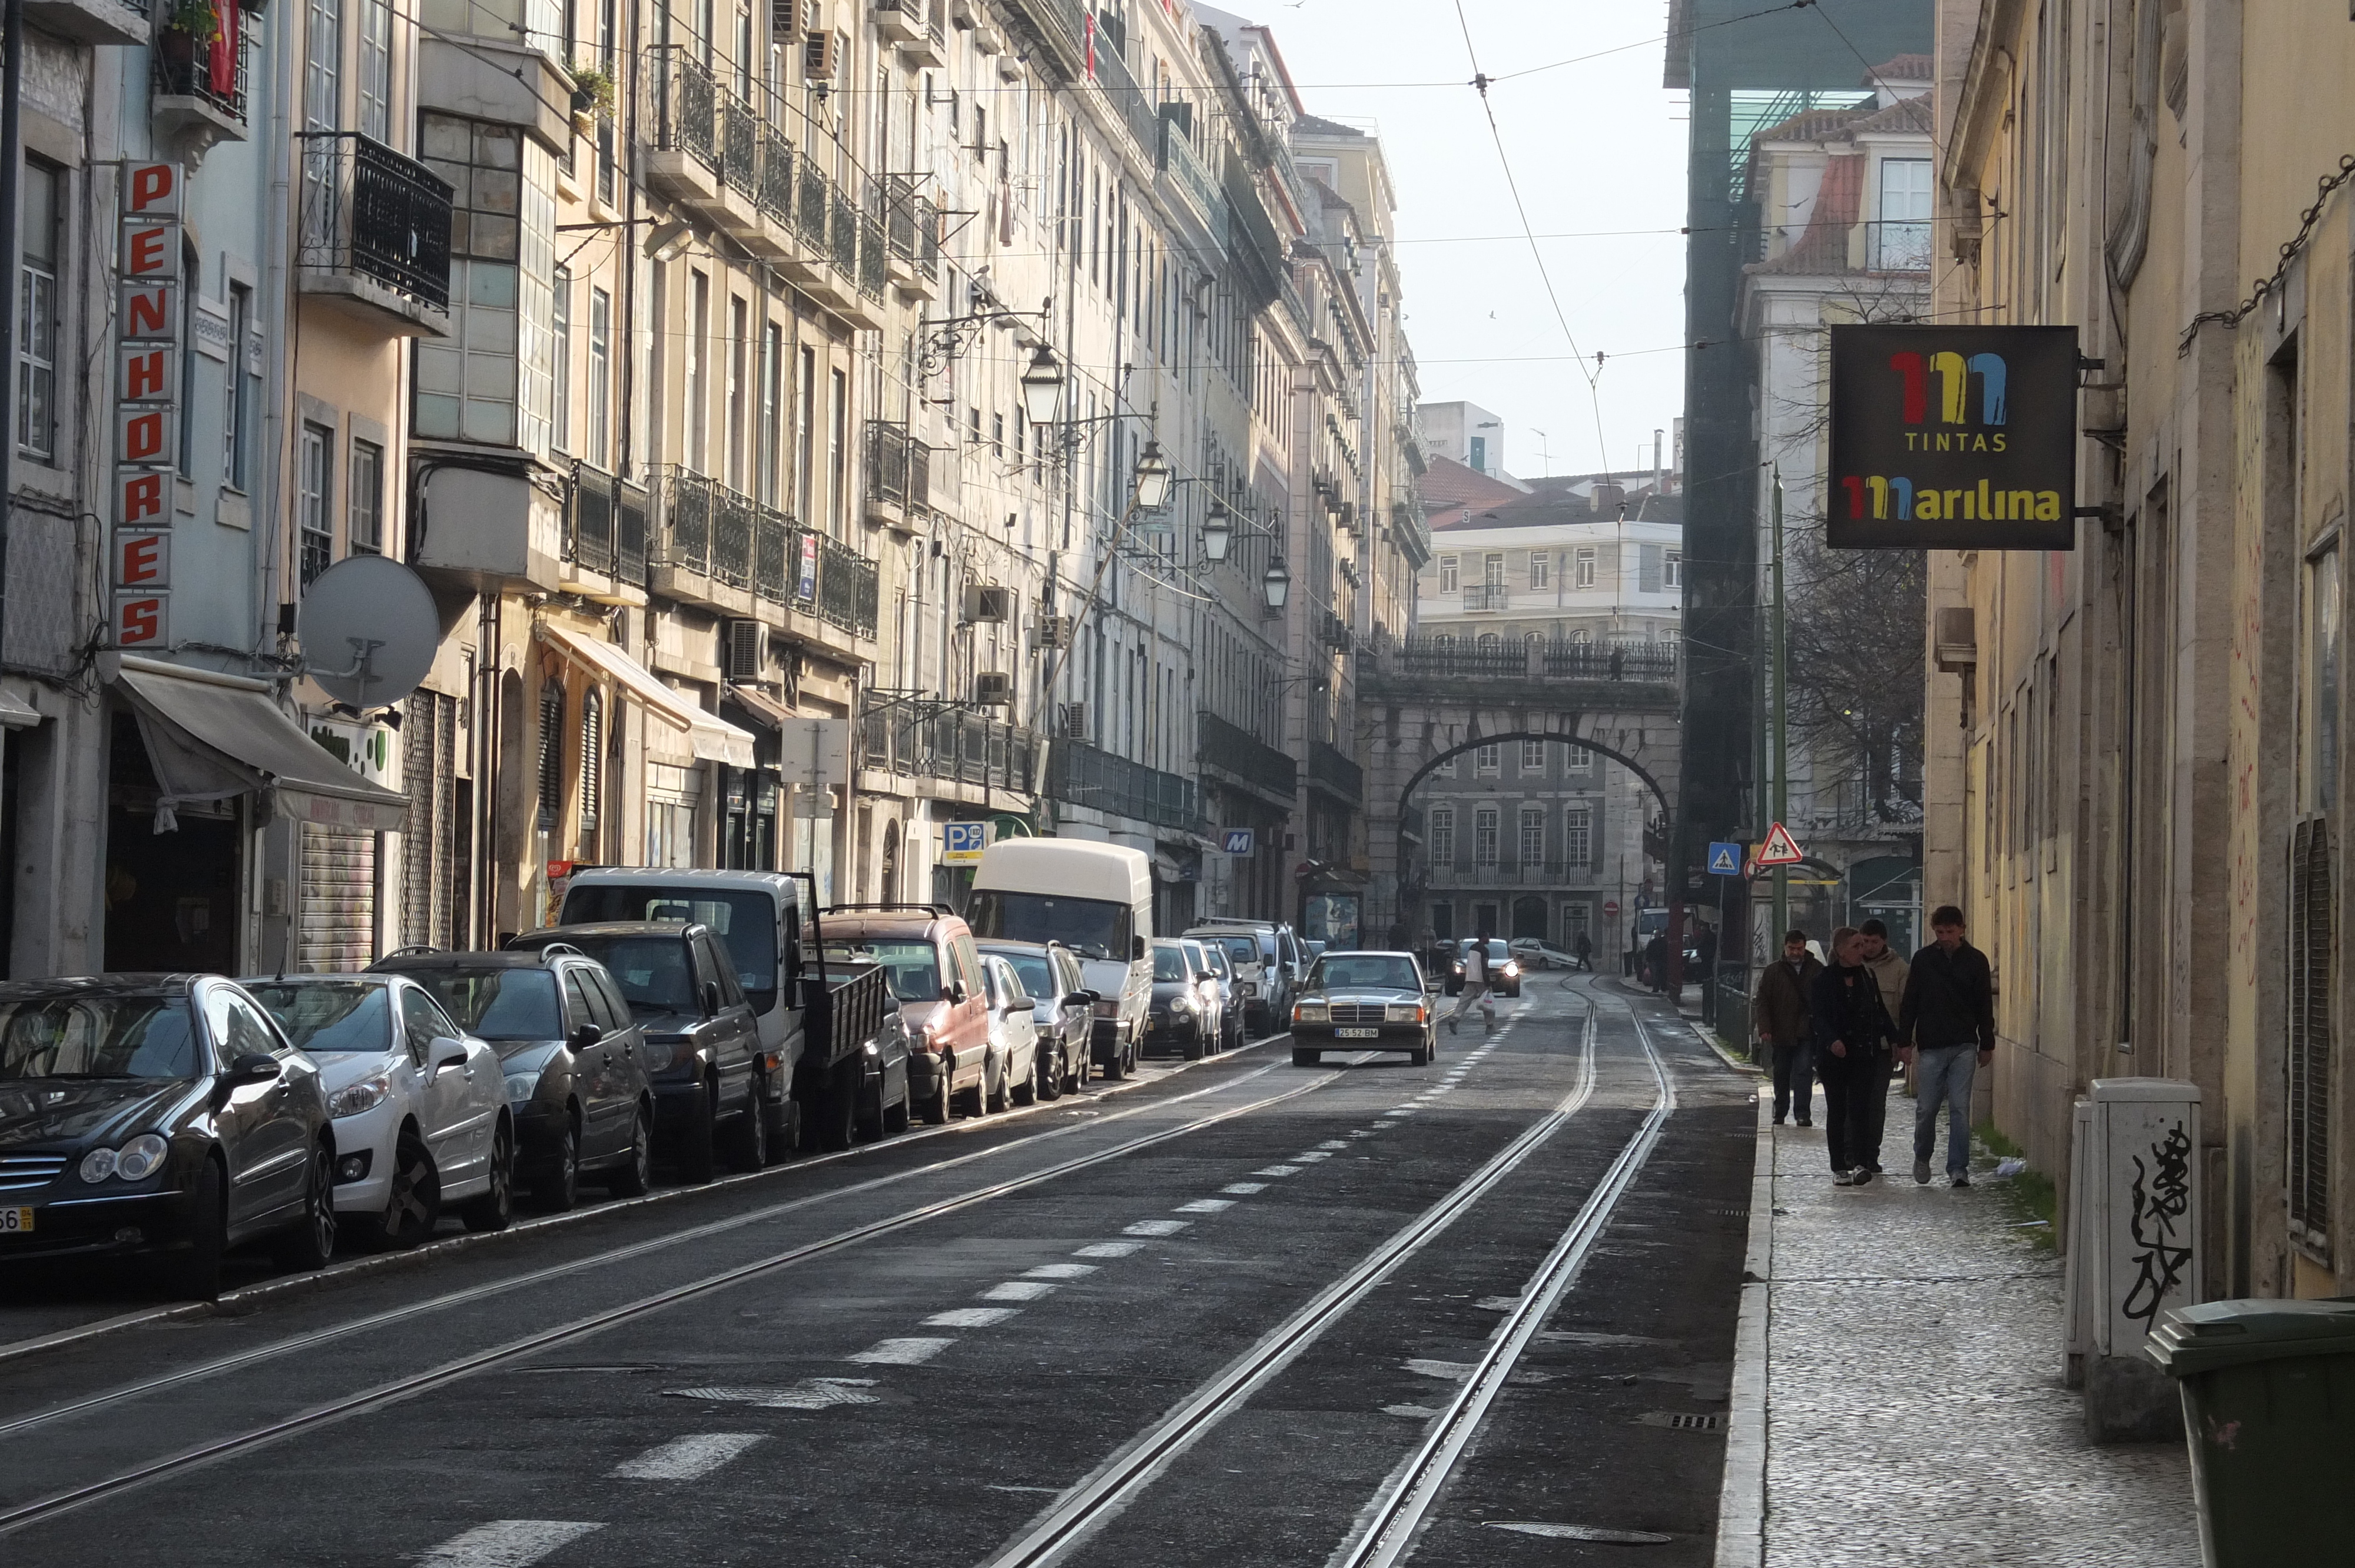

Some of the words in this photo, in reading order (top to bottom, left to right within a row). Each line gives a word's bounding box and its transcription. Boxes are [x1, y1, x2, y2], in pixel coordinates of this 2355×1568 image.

[121, 165, 172, 644] PENHORES
[1905, 432, 2007, 452] TINTAS
[948, 826, 967, 851] P
